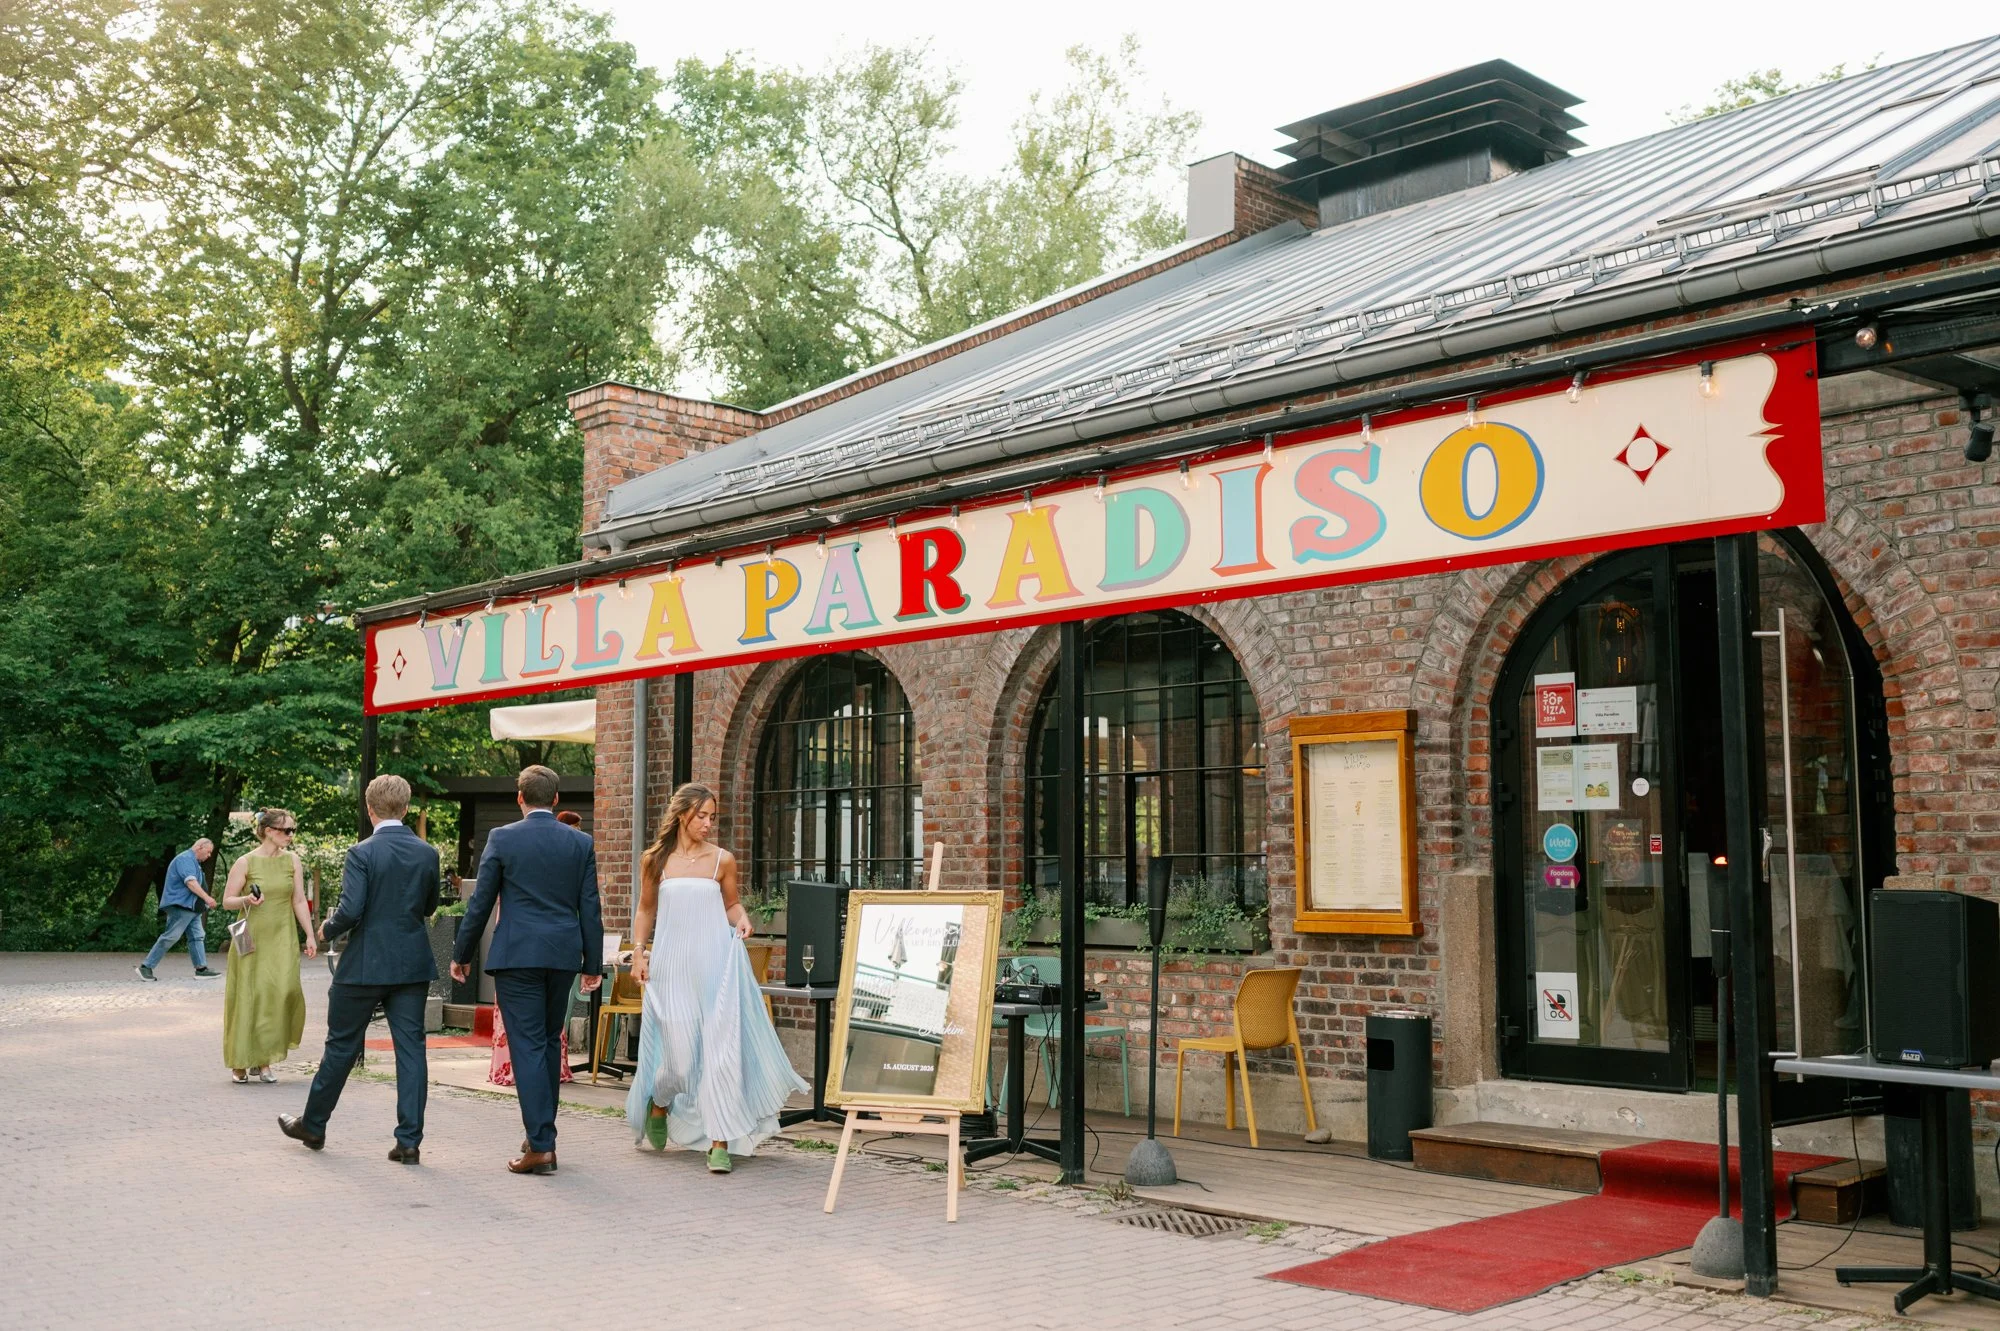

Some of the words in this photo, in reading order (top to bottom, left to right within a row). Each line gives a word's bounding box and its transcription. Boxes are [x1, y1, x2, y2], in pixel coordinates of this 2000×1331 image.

[421, 576, 703, 692] VILLA
[736, 421, 1546, 645] PARADISO
[1543, 696, 1564, 706] TOP
[1550, 837, 1572, 848] Wolt
[1550, 869, 1574, 877] foodora
[892, 1063, 920, 1071] AUGUST
